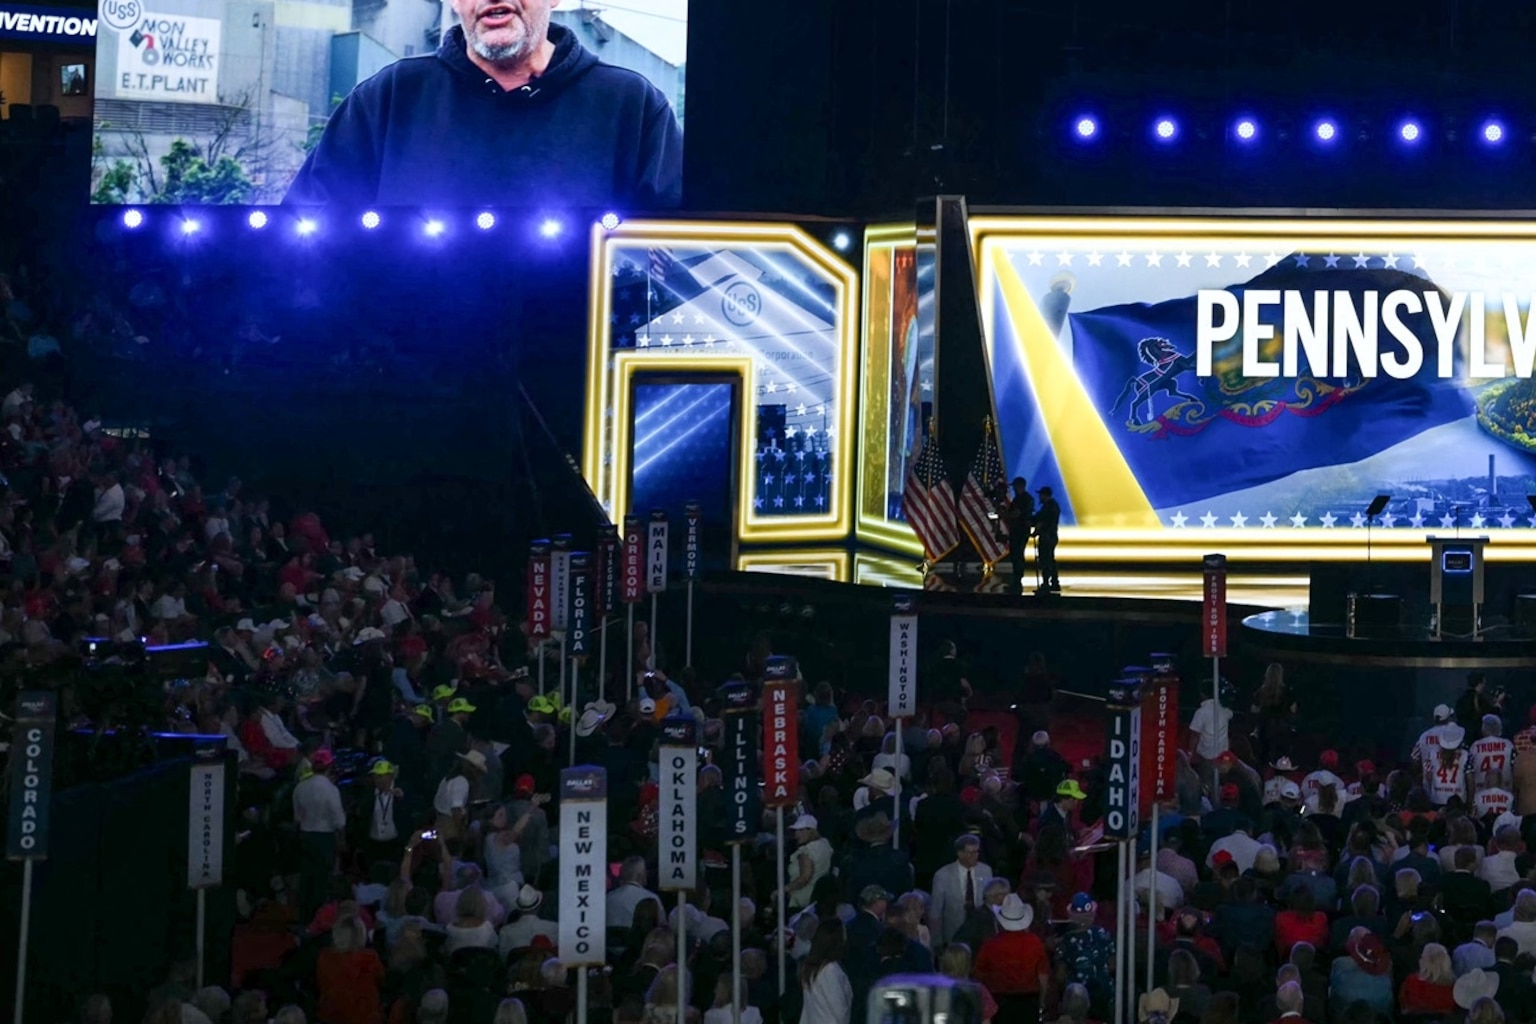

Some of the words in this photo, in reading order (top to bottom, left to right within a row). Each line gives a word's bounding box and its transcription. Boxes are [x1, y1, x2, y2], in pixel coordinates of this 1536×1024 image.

[0, 11, 98, 36] VENTION
[108, 1, 136, 20] USS
[140, 18, 186, 35] MON
[158, 36, 209, 53] VALLEY
[161, 53, 214, 70] WORKS
[627, 534, 638, 597] OREGON
[653, 527, 665, 586] MAINE
[686, 518, 697, 576] VERMONT
[533, 562, 545, 634] NEVADA
[573, 576, 585, 651] FLORIDA
[1210, 608, 1218, 626] ROW
[899, 623, 909, 709] WASHINGTON
[1158, 687, 1167, 727] SOUTH
[774, 690, 787, 797] NEBRASKA
[1108, 715, 1125, 830] IDAHO
[1130, 716, 1138, 829] IDAHO
[1156, 730, 1166, 795] CAROLINA
[1477, 742, 1506, 753] TRUMP
[1480, 755, 1506, 774] 47
[20, 728, 42, 849] COLORADO
[204, 773, 212, 811] NORTH
[735, 718, 747, 834] ILLINOIS
[1482, 794, 1509, 805] TRUMP
[203, 816, 211, 878] CAROLINA
[575, 811, 592, 854] NEW
[671, 756, 685, 879] OKLAHOMA
[575, 864, 591, 954] MEXICO
